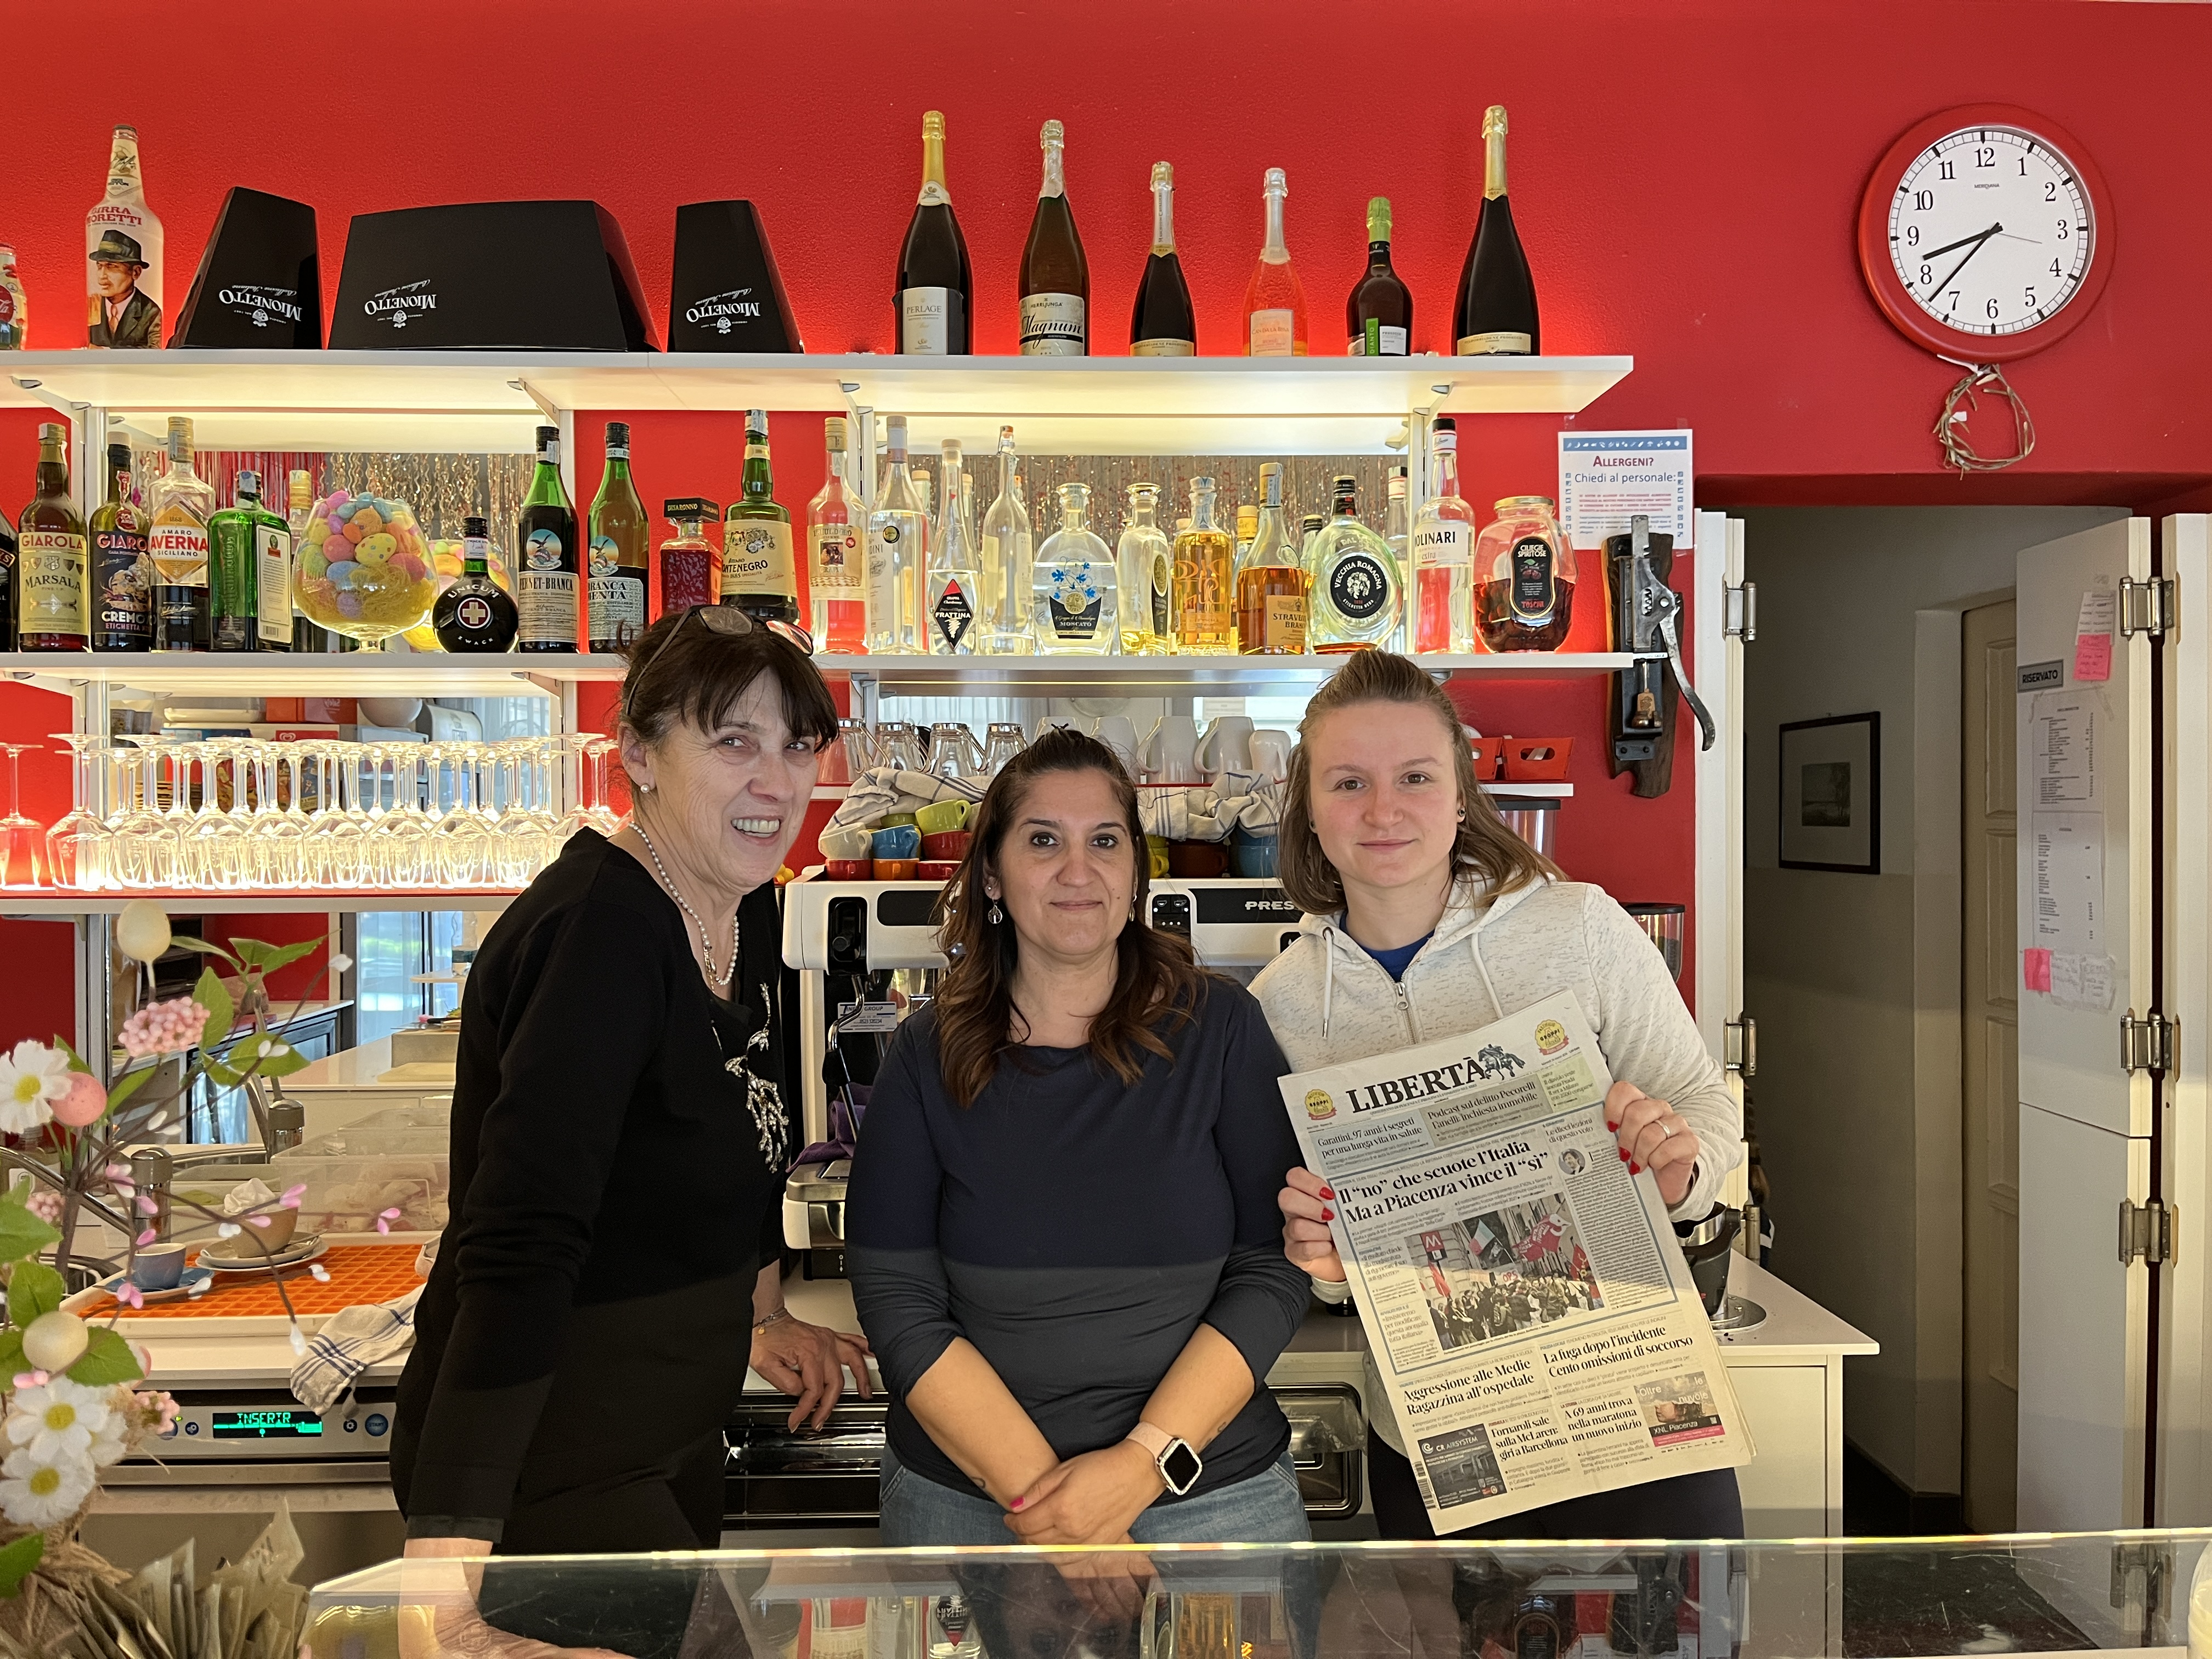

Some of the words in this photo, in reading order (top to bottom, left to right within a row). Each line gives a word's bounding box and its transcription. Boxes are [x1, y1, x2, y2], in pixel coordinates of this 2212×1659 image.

[1974, 147, 1995, 167] 12
[2018, 157, 2028, 176] 1
[1938, 161, 1956, 180] 11
[1913, 190, 1933, 211] 10
[2045, 182, 2056, 202] 2
[1908, 226, 1919, 246] 9
[2057, 219, 2068, 240] 3
[1920, 264, 1932, 285] 8
[2049, 258, 2062, 277] 4
[1948, 291, 1960, 311] 7
[2024, 286, 2036, 307] 5
[906, 304, 942, 314] PERLAGE
[1987, 298, 1998, 319] 6
[1593, 455, 1654, 467] ALLERGENI?
[1575, 472, 1607, 483] Chiedi
[1610, 472, 1618, 482] al
[1622, 472, 1676, 484] personale:
[667, 503, 698, 511] DISARONNO
[21, 535, 83, 550] GIAROLA
[151, 535, 209, 551] AVERNA
[723, 560, 768, 573] ONTENEGRO
[1334, 562, 1356, 589] VECCHIA
[1357, 560, 1382, 590] ROMAGNA
[25, 574, 82, 594] MARSALA
[447, 584, 500, 599] UNICUM
[457, 635, 494, 645] ZWACK
[2022, 669, 2058, 684] RISERVATO
[1427, 1105, 1460, 1119] Podcast
[1460, 1100, 1474, 1109] sul
[1474, 1094, 1499, 1106] delitto
[1499, 1081, 1536, 1098] Pecorelli
[1460, 1105, 1498, 1121] inchiesta
[1497, 1093, 1537, 1110] immobile
[1318, 1132, 1353, 1146] Garattini,
[1352, 1130, 1361, 1138] 97
[1363, 1125, 1383, 1136] anni:
[1387, 1116, 1414, 1130] segreti
[1322, 1149, 1334, 1159] per
[1335, 1146, 1351, 1154] una
[1350, 1141, 1373, 1150] lunga
[1373, 1136, 1389, 1144] vita
[1398, 1127, 1422, 1137] salute
[1338, 1188, 1352, 1204] Il
[1393, 1174, 1422, 1189] che
[1424, 1158, 1477, 1181] scuote
[1477, 1142, 1531, 1164] l’Italia
[1345, 1206, 1372, 1223] Ma
[1373, 1204, 1385, 1215] a
[1384, 1182, 1458, 1212] Piacenza
[1458, 1169, 1503, 1189] vince
[1504, 1161, 1517, 1177] il
[1502, 1272, 1518, 1282] OPS
[1543, 1353, 1558, 1363] La
[1558, 1347, 1582, 1360] fuga
[1583, 1341, 1610, 1353] dopo
[1610, 1327, 1666, 1347] l’incidente
[1549, 1363, 1579, 1377] Cento
[1581, 1347, 1632, 1369] omissioni
[1634, 1345, 1644, 1357] di
[1645, 1337, 1692, 1353] soccorso
[1404, 1376, 1470, 1402] Aggressione
[1472, 1369, 1493, 1382] alle
[1494, 1359, 1531, 1375] Medie
[1638, 1384, 1662, 1397] Oltre
[1694, 1375, 1703, 1385] le
[1407, 1393, 1464, 1415] Ragazzina
[1466, 1374, 1534, 1400] all’ospedale
[1678, 1390, 1708, 1404] nuvole
[1573, 1407, 1584, 1417] 69
[1586, 1401, 1607, 1414] anni
[1608, 1398, 1633, 1409] trova
[236, 1412, 291, 1425] INSERIR
[1532, 1417, 1549, 1426] sale
[1568, 1419, 1591, 1430] nella
[1592, 1409, 1637, 1425] maratona
[1653, 1426, 1668, 1435] XNL
[1668, 1419, 1698, 1432] Piacenza
[1496, 1437, 1517, 1448] sulla
[1516, 1427, 1558, 1442] McLaren:
[1572, 1434, 1584, 1442] un
[1585, 1427, 1614, 1438] nuovo
[1615, 1419, 1641, 1432] inizio
[1499, 1448, 1515, 1462] giri
[1521, 1437, 1568, 1454] Barcellona
